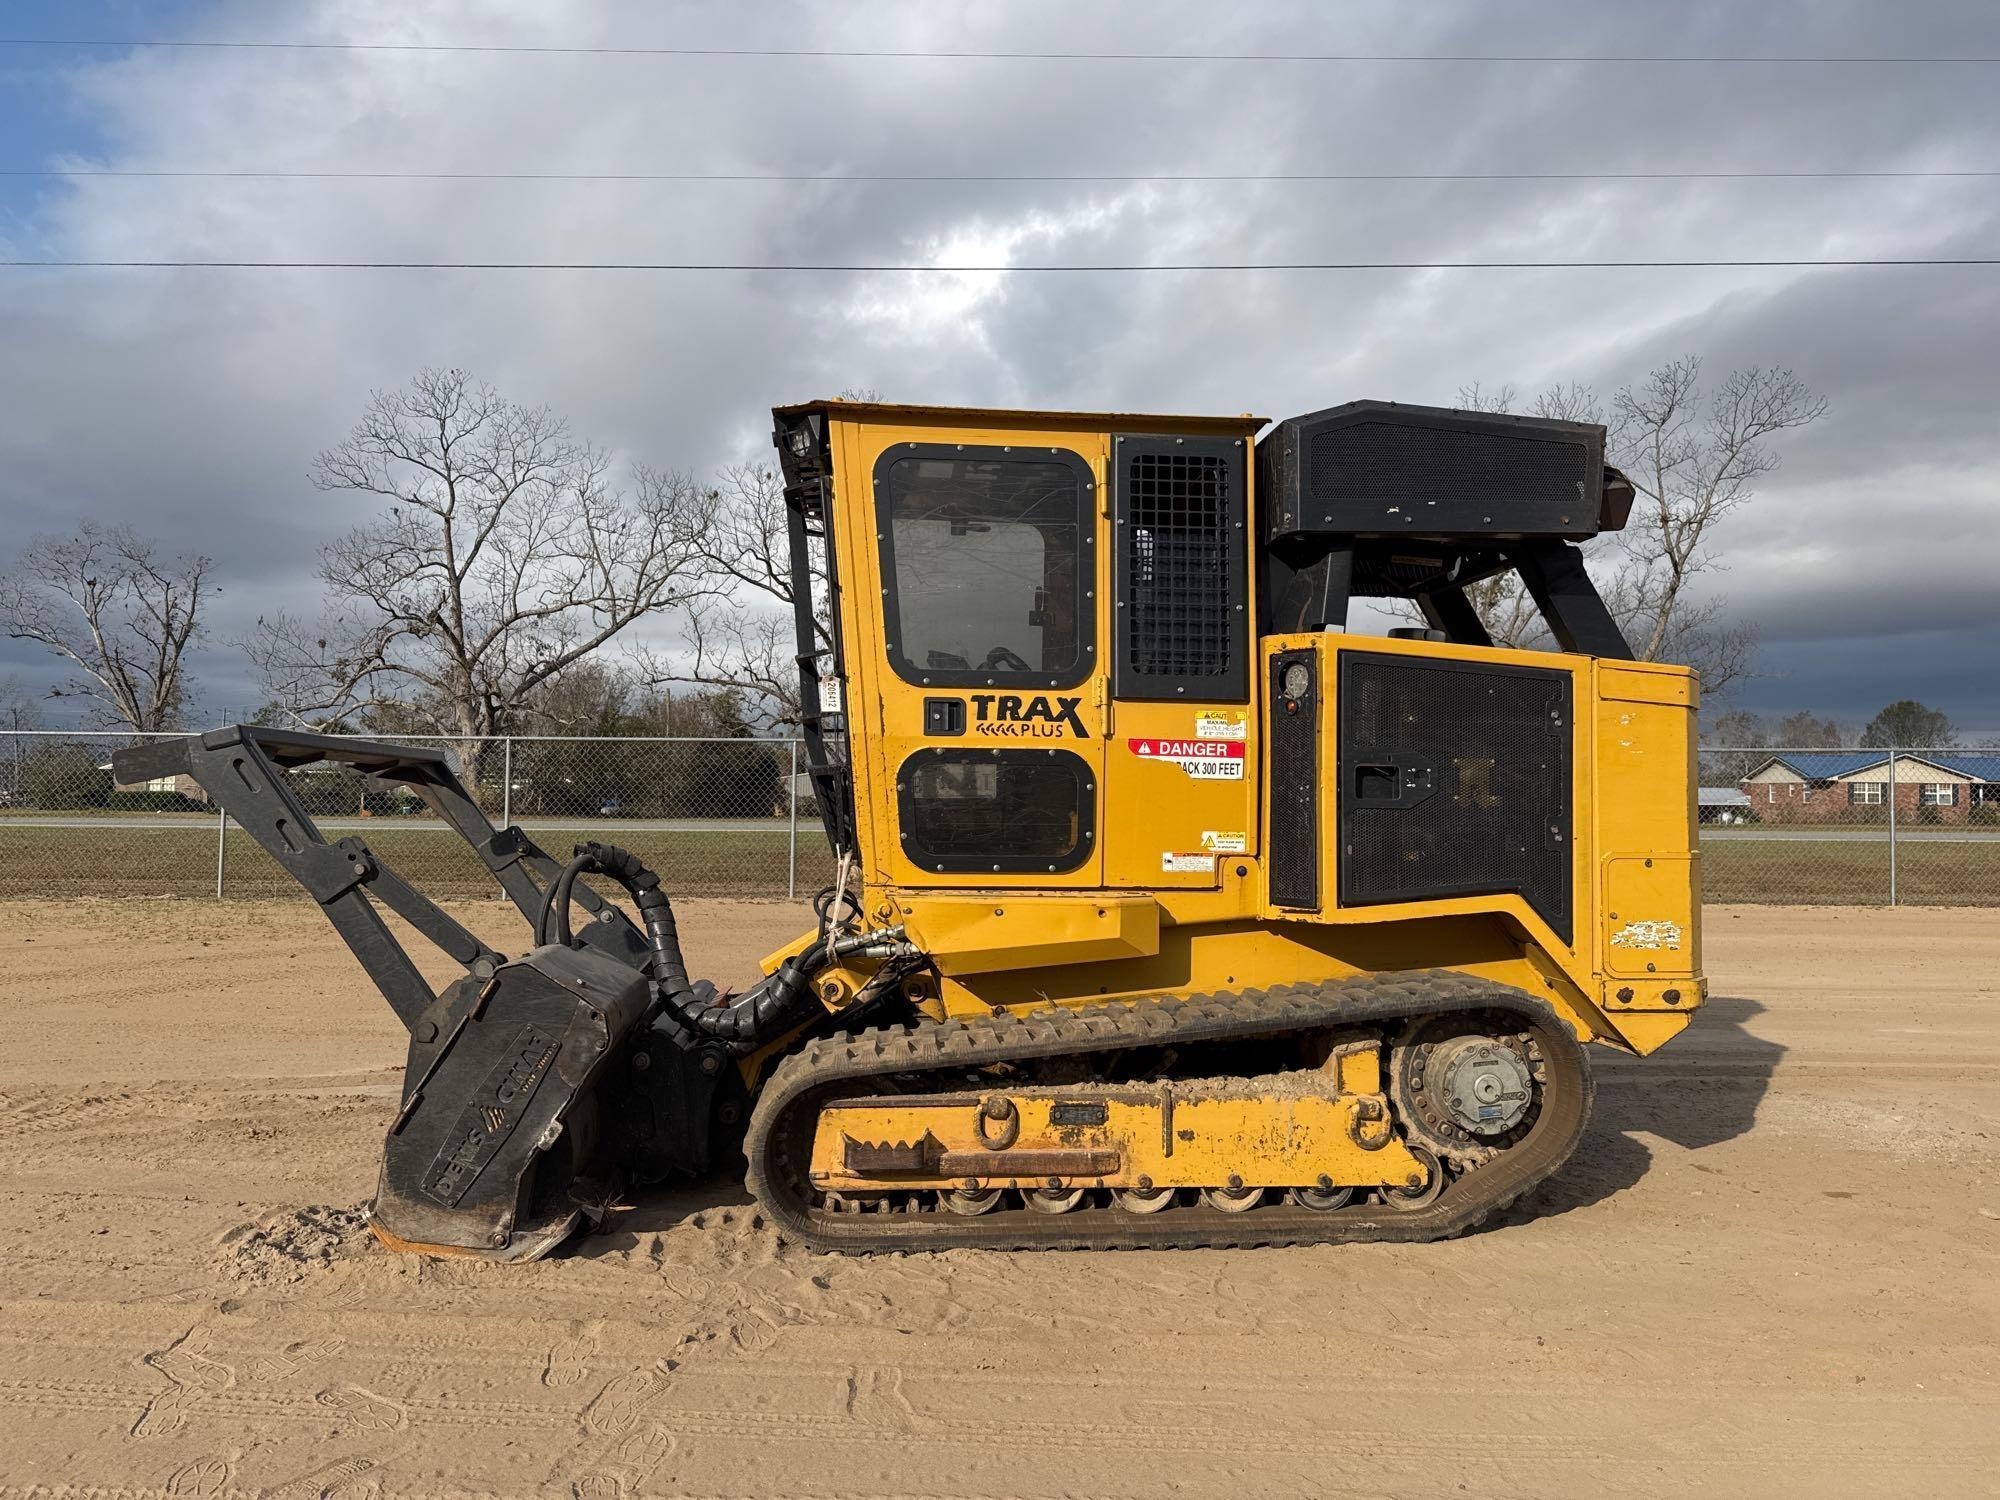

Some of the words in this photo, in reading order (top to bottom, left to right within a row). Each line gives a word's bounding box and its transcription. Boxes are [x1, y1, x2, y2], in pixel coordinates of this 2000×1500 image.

[970, 695, 1090, 738] TRAX
[1021, 723, 1063, 737] PLUS
[1159, 741, 1228, 756] DANGER
[1177, 761, 1200, 775] ACK
[1202, 762, 1217, 775] 300
[1218, 763, 1241, 775] FEET
